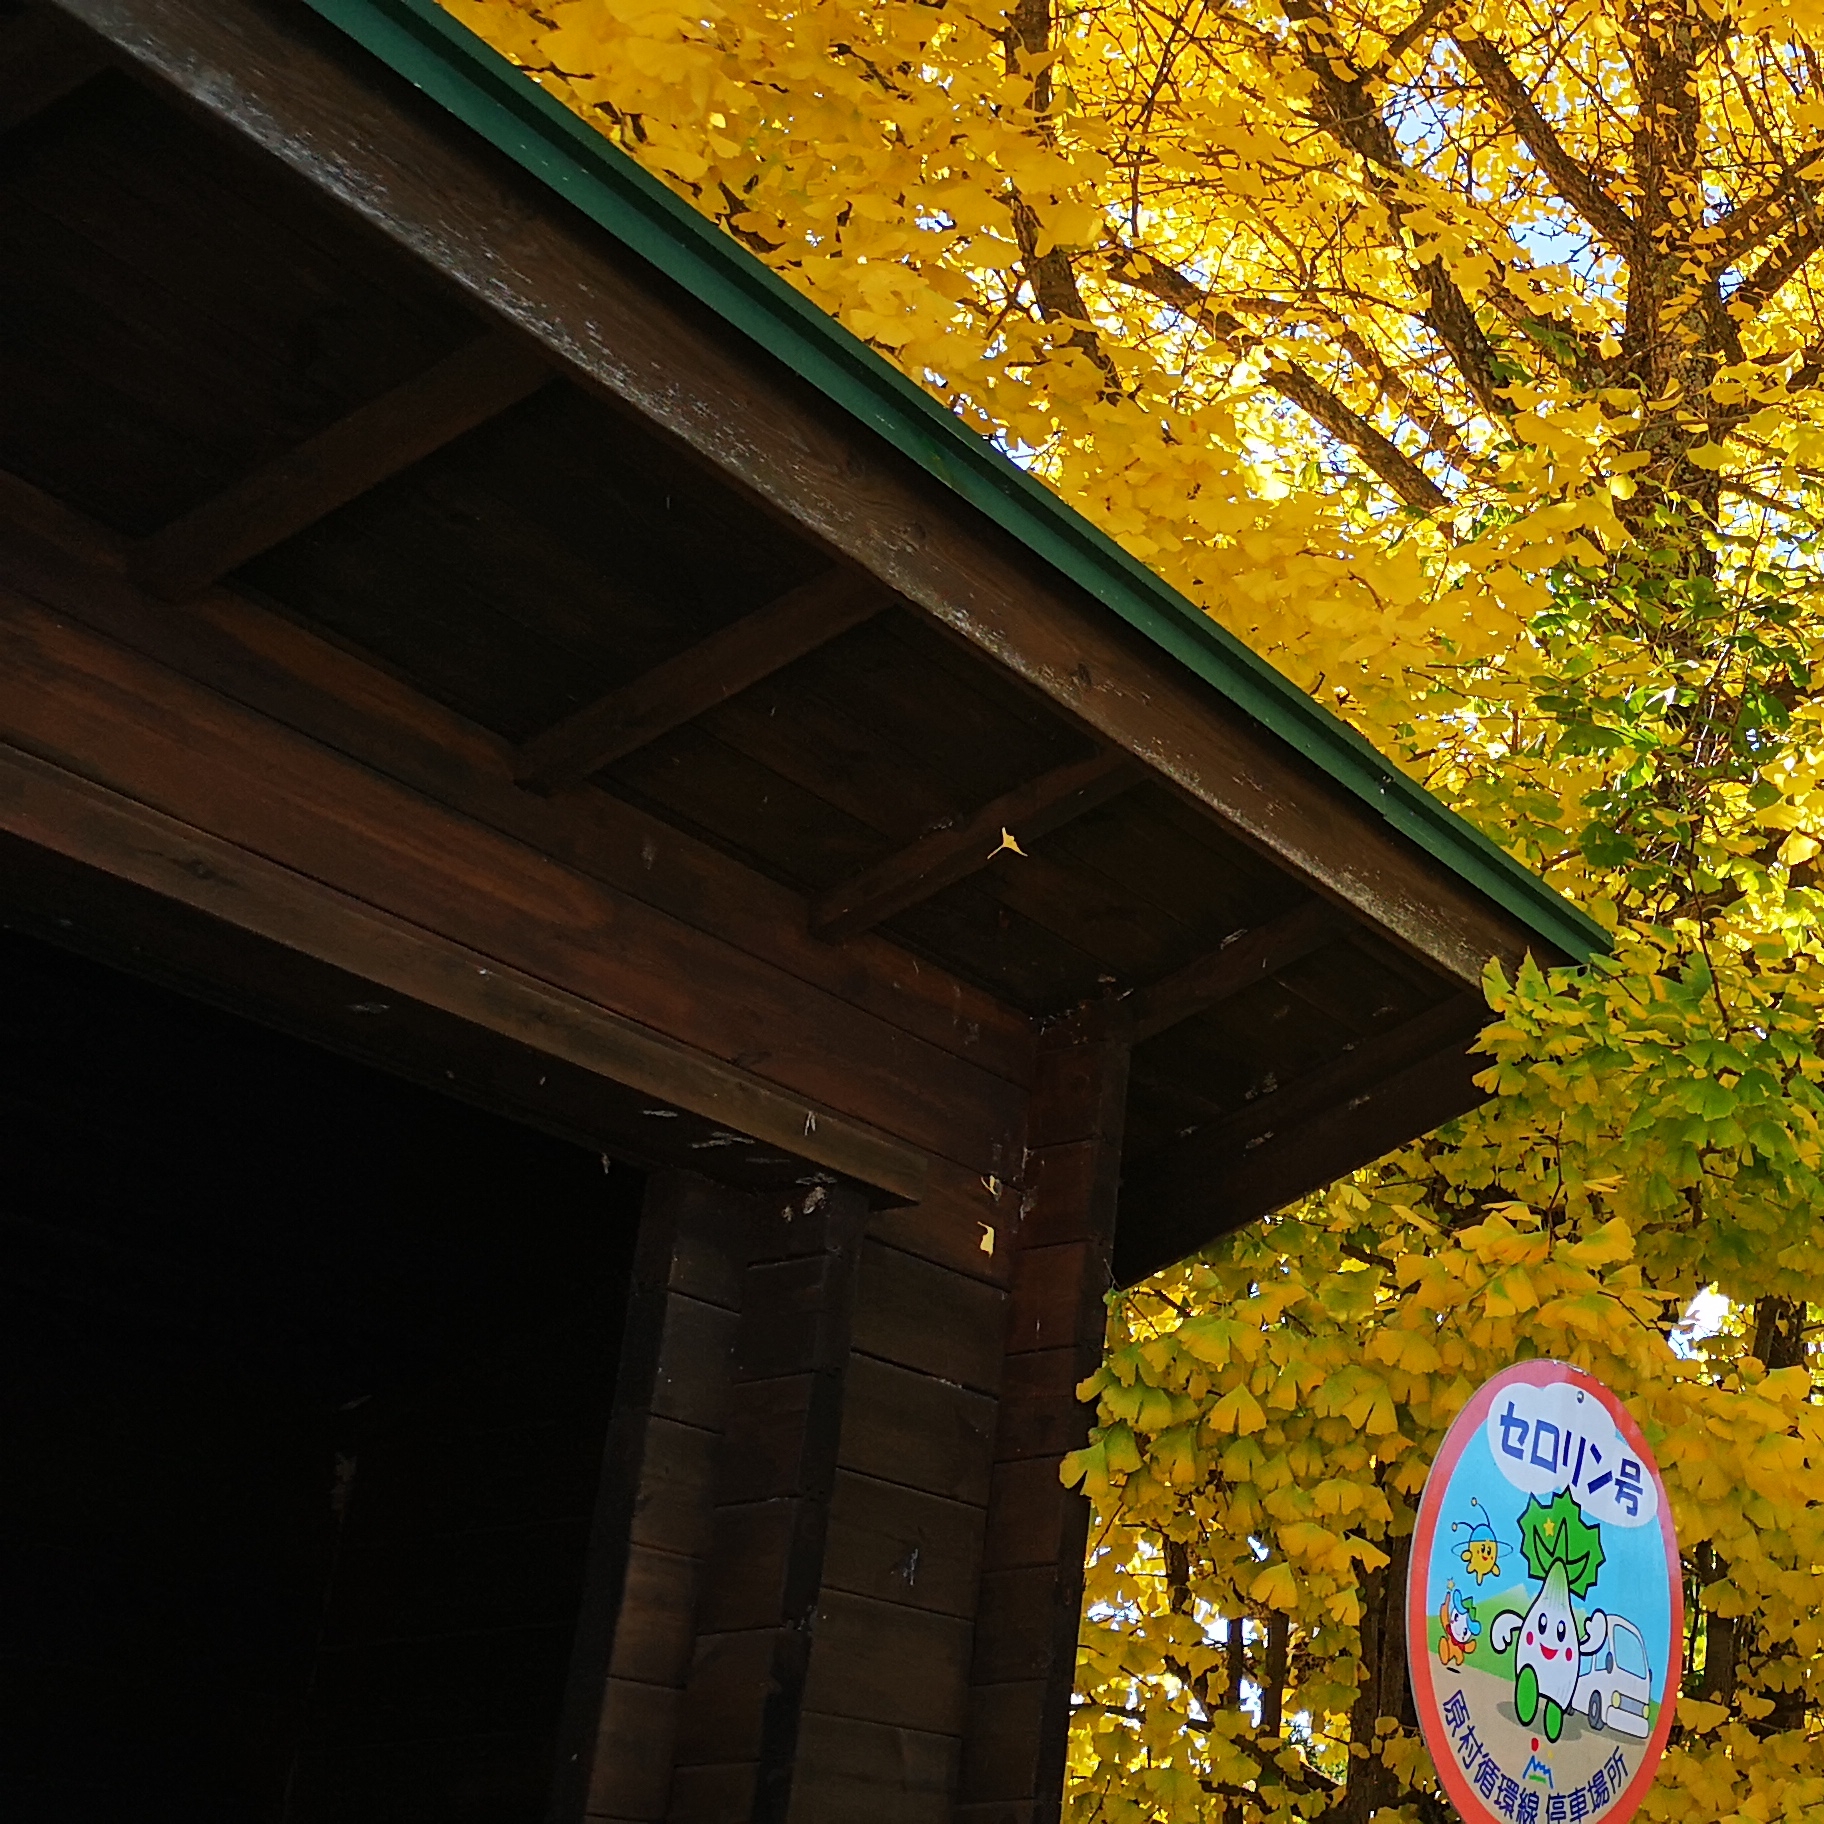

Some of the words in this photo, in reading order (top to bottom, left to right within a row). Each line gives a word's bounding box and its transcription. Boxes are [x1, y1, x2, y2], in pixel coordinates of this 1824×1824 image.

[1500, 1401, 1644, 1517] セロリン号
[1443, 1689, 1540, 1824] 原村循環線
[1545, 1745, 1629, 1824] 停車場所
